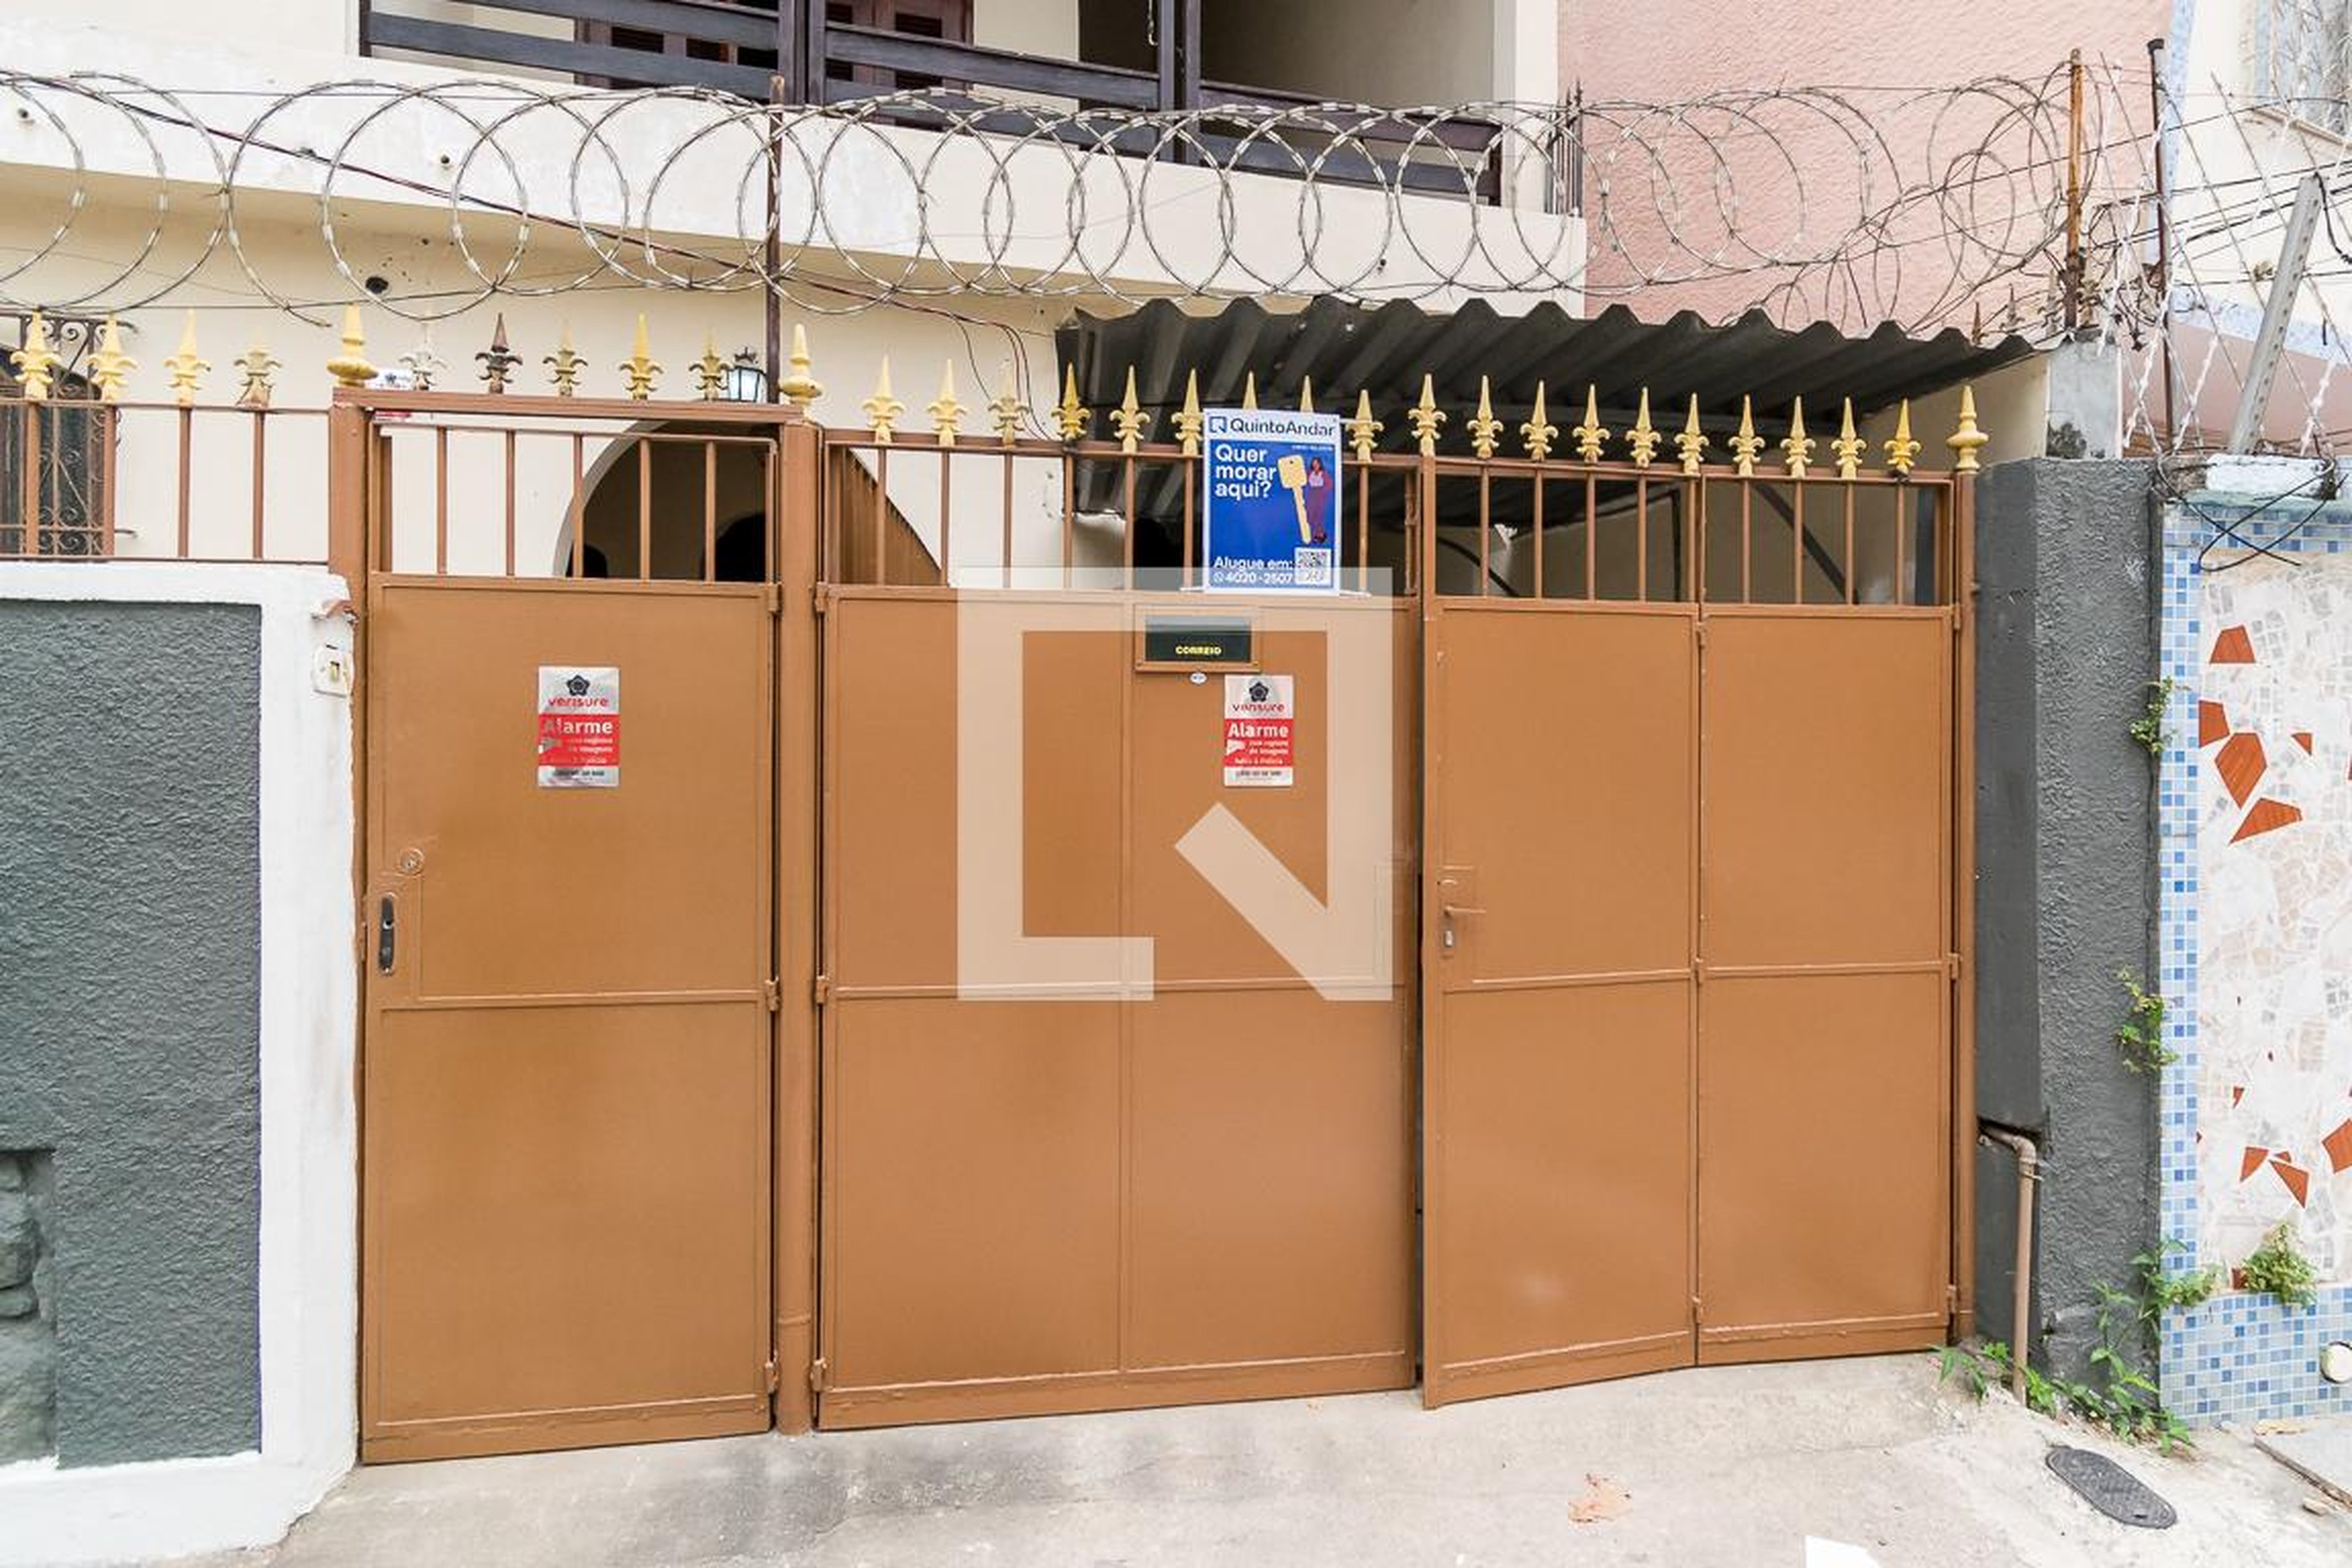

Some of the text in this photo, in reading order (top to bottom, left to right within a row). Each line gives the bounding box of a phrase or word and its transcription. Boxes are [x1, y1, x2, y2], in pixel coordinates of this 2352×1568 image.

[1231, 418, 1335, 435] QuintoAndar
[1215, 444, 1267, 462] Quer
[1215, 465, 1276, 480] morar
[1215, 480, 1271, 500] aqui?
[1214, 556, 1292, 571] Alugue em:
[1175, 646, 1222, 655] CORREIO
[549, 697, 609, 707] verisure
[1228, 722, 1289, 737] Alarme
